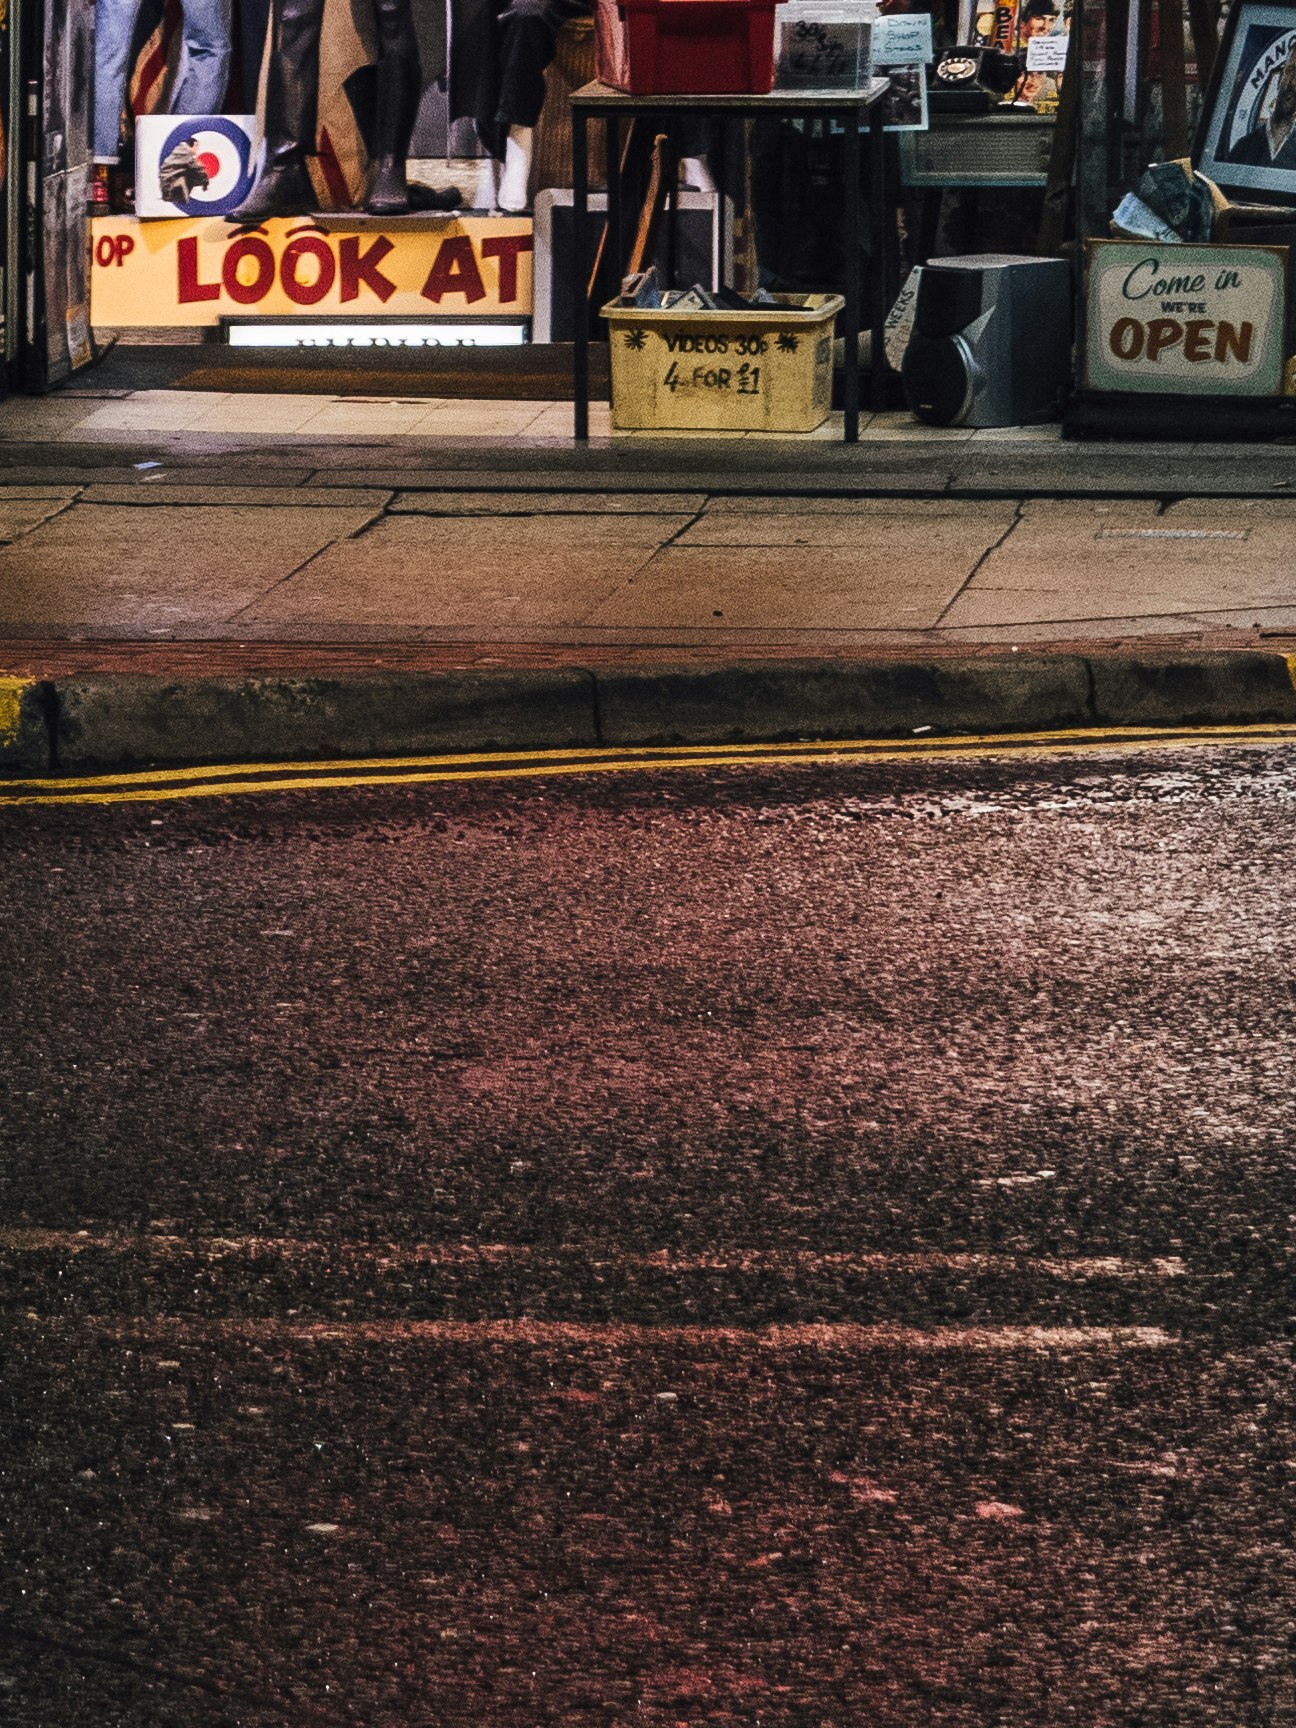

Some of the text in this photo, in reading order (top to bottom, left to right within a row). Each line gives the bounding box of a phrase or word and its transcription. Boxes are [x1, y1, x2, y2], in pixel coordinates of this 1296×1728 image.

[92, 228, 534, 305] OP LOOK AT
[1122, 257, 1241, 301] Come in
[1160, 301, 1207, 314] WE'RE
[663, 328, 728, 354] VIDEOS
[1109, 316, 1253, 363] OPEN
[662, 361, 679, 392] 4
[692, 367, 730, 388] FOR
